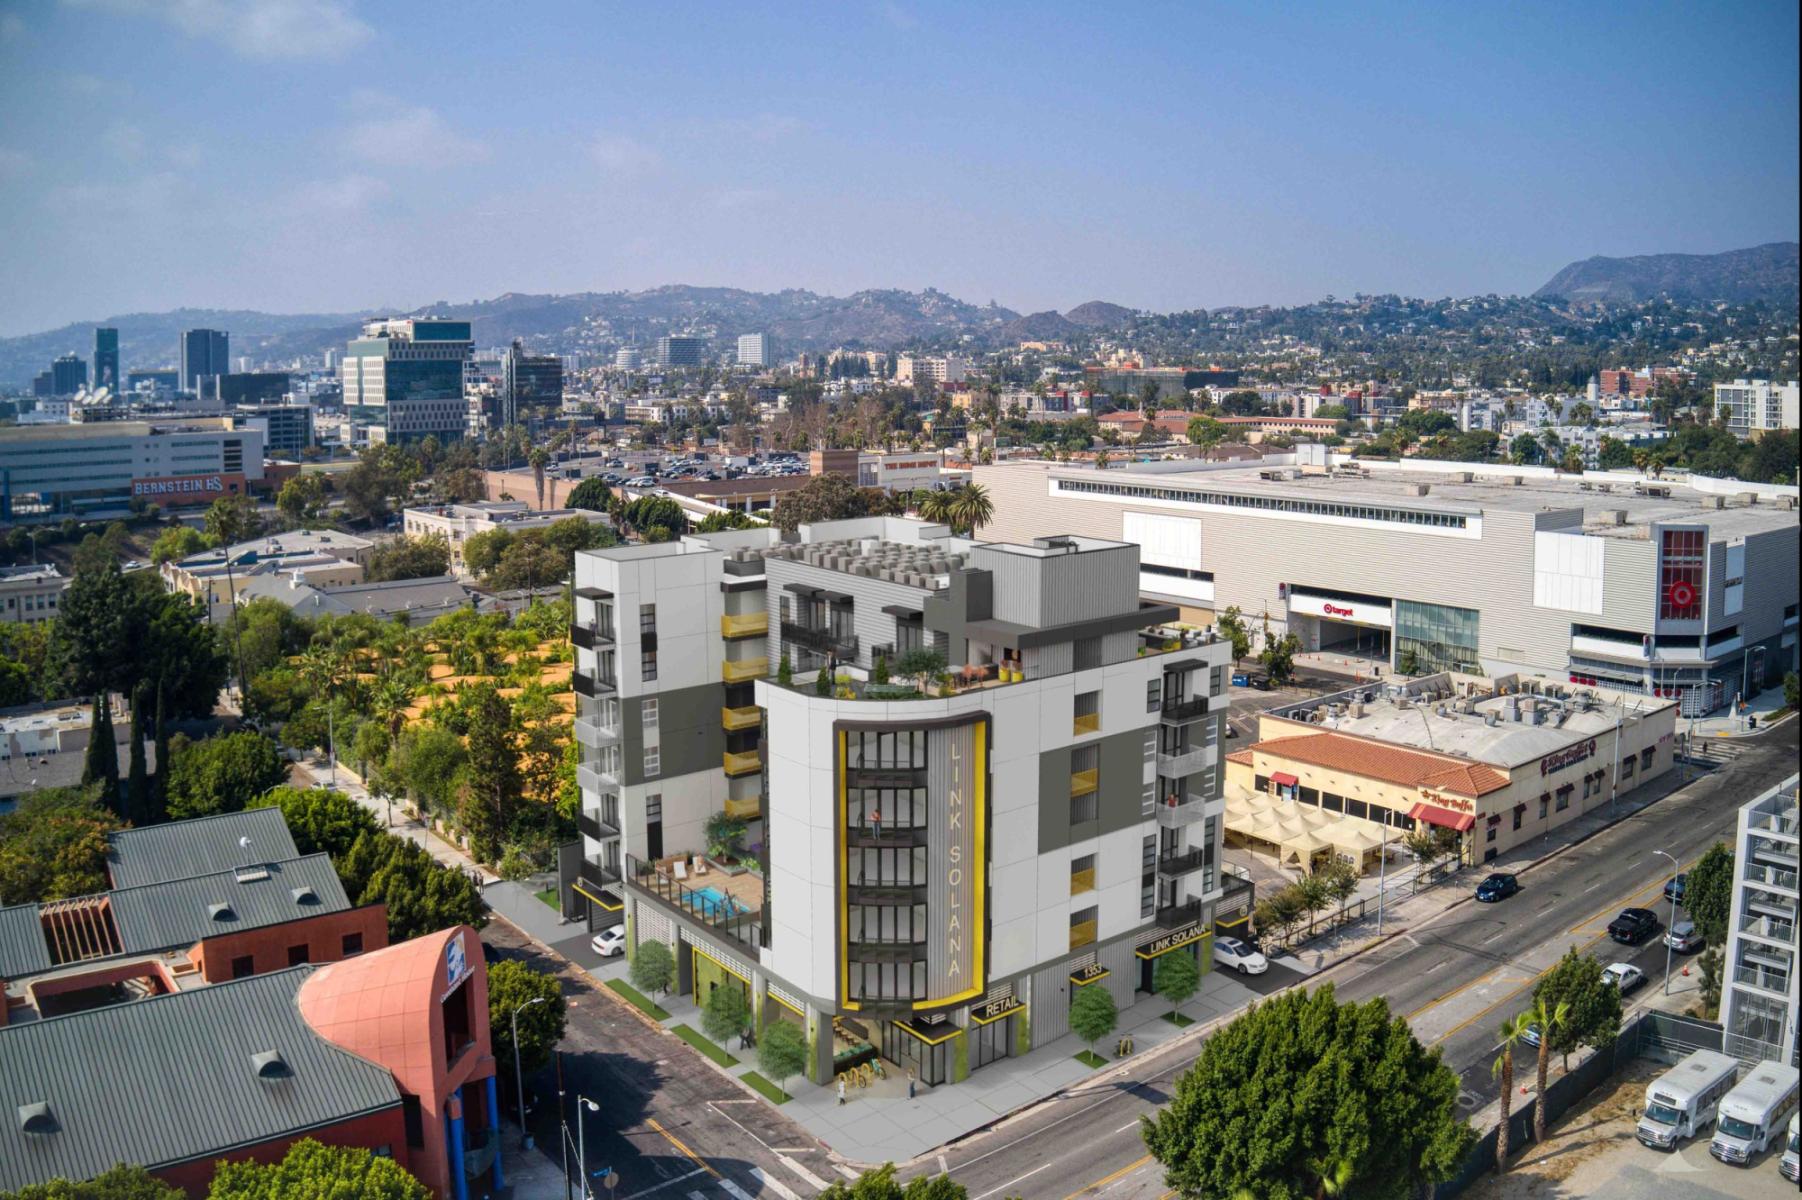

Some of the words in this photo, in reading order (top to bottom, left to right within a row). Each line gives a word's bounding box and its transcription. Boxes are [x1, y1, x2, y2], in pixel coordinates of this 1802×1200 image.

[135, 479, 203, 495] BERNSTEIN
[1332, 606, 1353, 617] target
[950, 743, 961, 830] LINK
[949, 846, 961, 977] SOLANA
[1151, 938, 1172, 954] LINK
[1172, 924, 1206, 945] SOLANA
[1084, 963, 1102, 978] 1353
[986, 996, 1019, 1017] RETAIL
